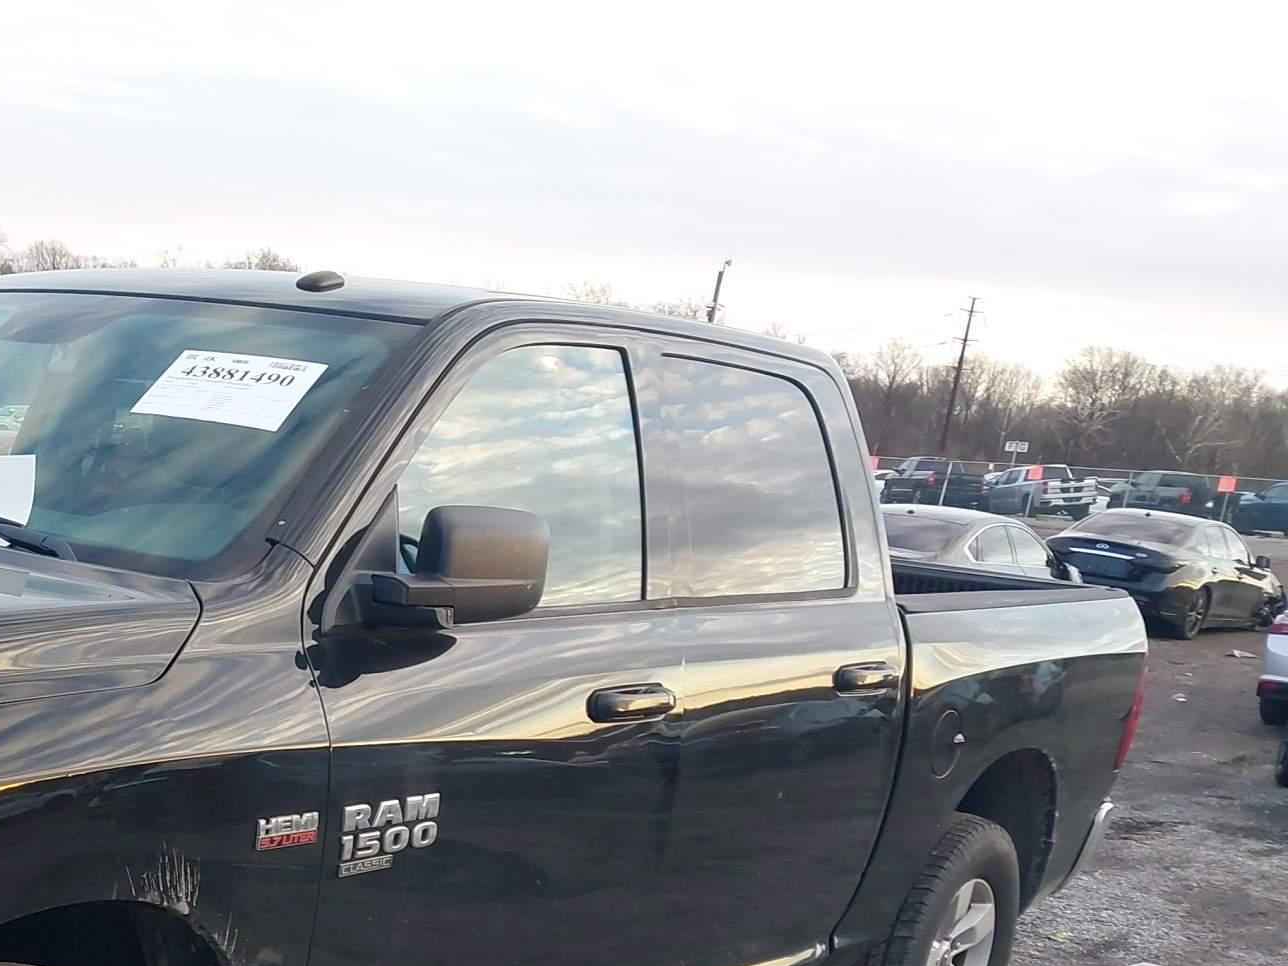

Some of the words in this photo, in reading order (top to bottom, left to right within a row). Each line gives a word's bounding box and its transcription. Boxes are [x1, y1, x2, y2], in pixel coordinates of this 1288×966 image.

[181, 365, 295, 387] 43881490
[258, 811, 319, 836] HEMI
[342, 793, 441, 832] RAM
[341, 821, 438, 861] 1500
[341, 857, 392, 875] CLASSIC
